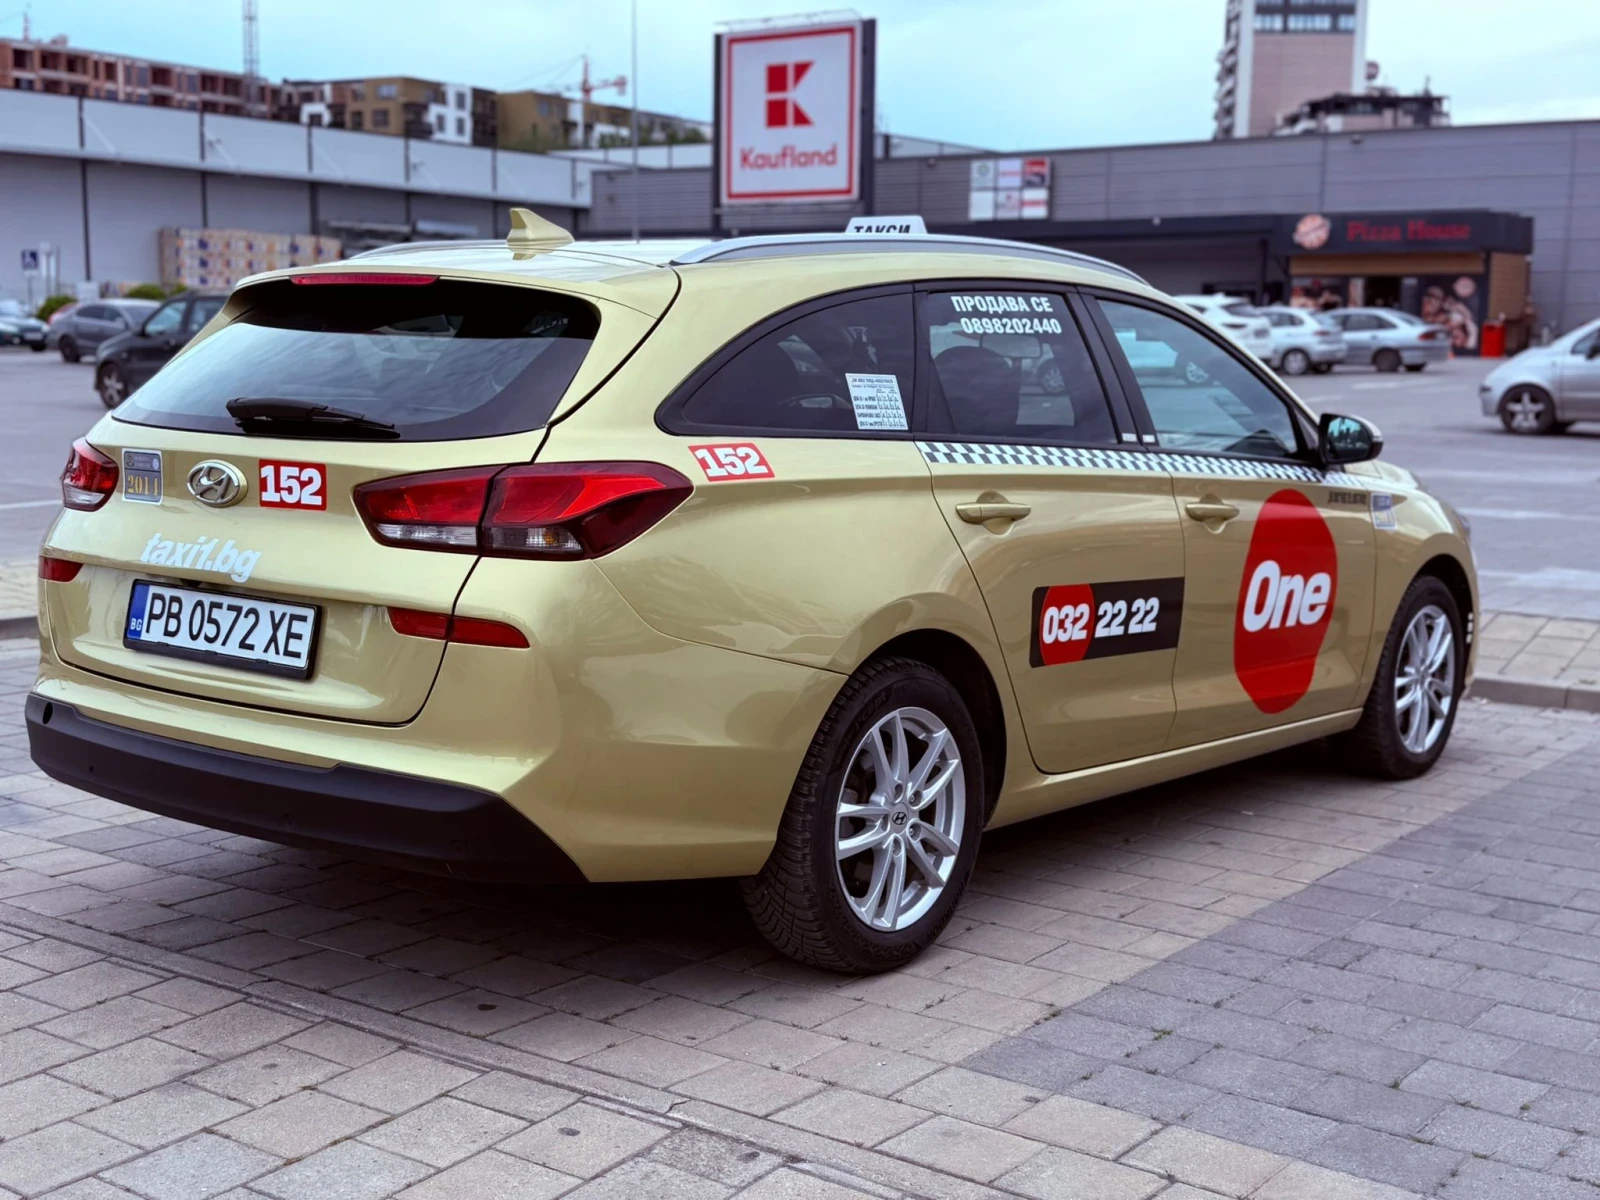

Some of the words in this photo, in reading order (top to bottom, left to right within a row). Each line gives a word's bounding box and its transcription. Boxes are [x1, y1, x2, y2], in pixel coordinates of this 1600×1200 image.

[766, 61, 814, 128] K
[740, 144, 837, 170] Kaufland
[1347, 221, 1401, 241] Pizza
[1407, 219, 1471, 239] House
[950, 296, 1031, 314] ПРОДАВА
[1030, 296, 1053, 312] СЕ
[960, 317, 1062, 334] 0898202440
[694, 446, 769, 477] 152
[260, 464, 322, 505] 152
[140, 532, 262, 583] taxi1.bg
[1242, 560, 1331, 632] One
[131, 618, 142, 631] BG
[146, 592, 183, 638] PB
[189, 599, 260, 651] 0572
[263, 610, 308, 659] XE
[1042, 603, 1089, 644] 032
[1094, 600, 1127, 638] 22
[1127, 597, 1160, 634] 22
